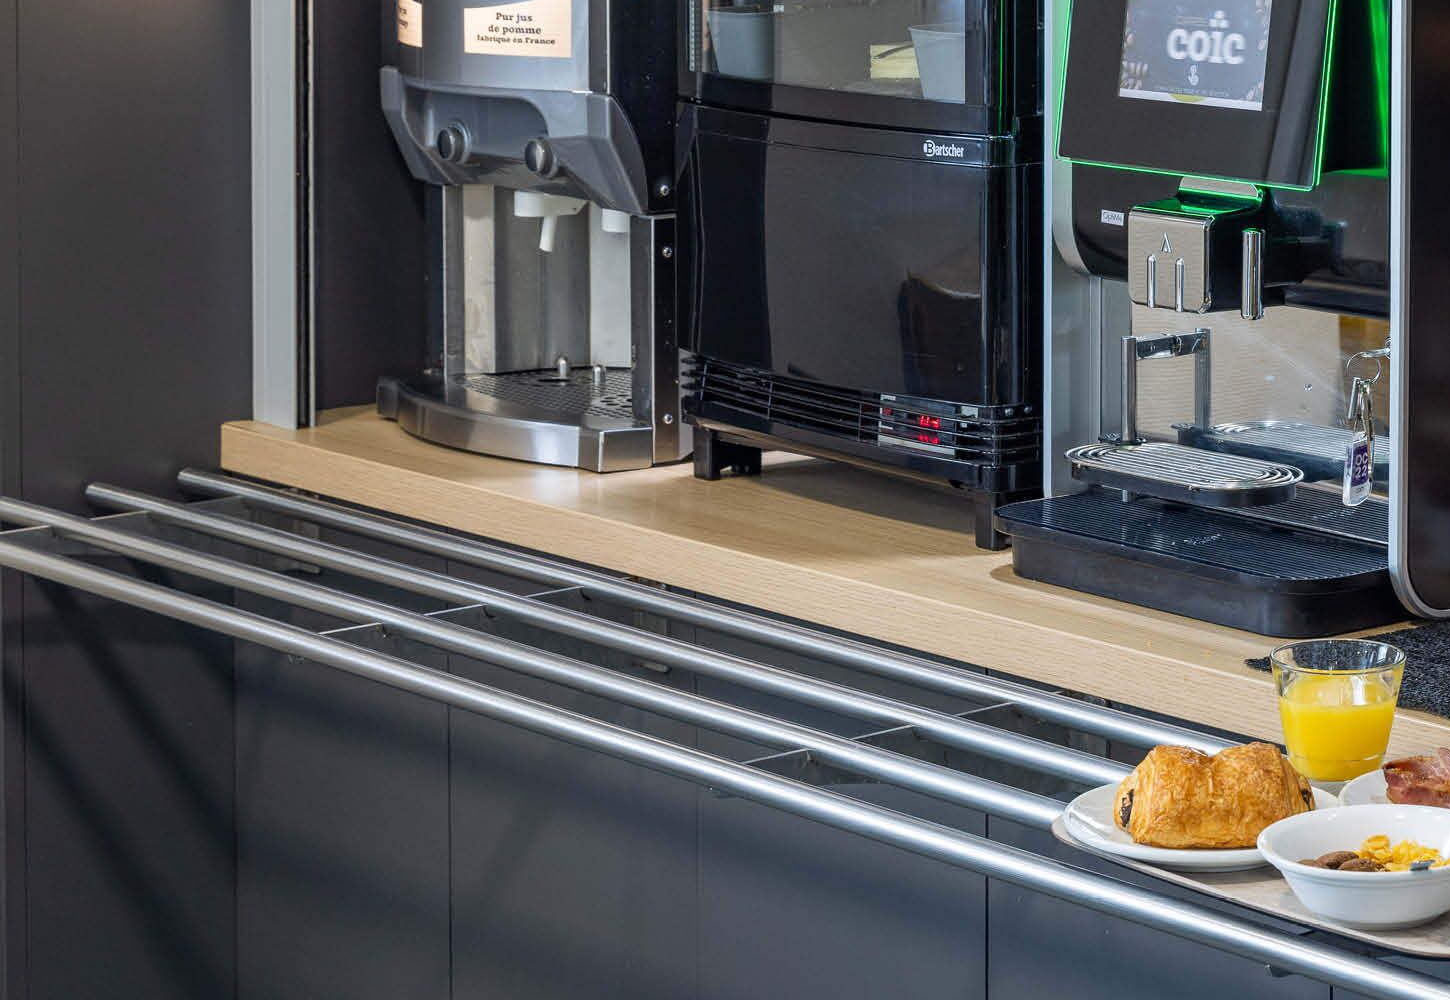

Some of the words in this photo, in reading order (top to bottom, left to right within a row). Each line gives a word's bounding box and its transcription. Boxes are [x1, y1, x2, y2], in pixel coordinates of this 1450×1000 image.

[496, 12, 514, 22] Pur
[516, 13, 534, 24] jus
[488, 24, 500, 34] de
[502, 25, 542, 36] pomme
[525, 37, 556, 45] France
[923, 139, 965, 158] Bartscher
